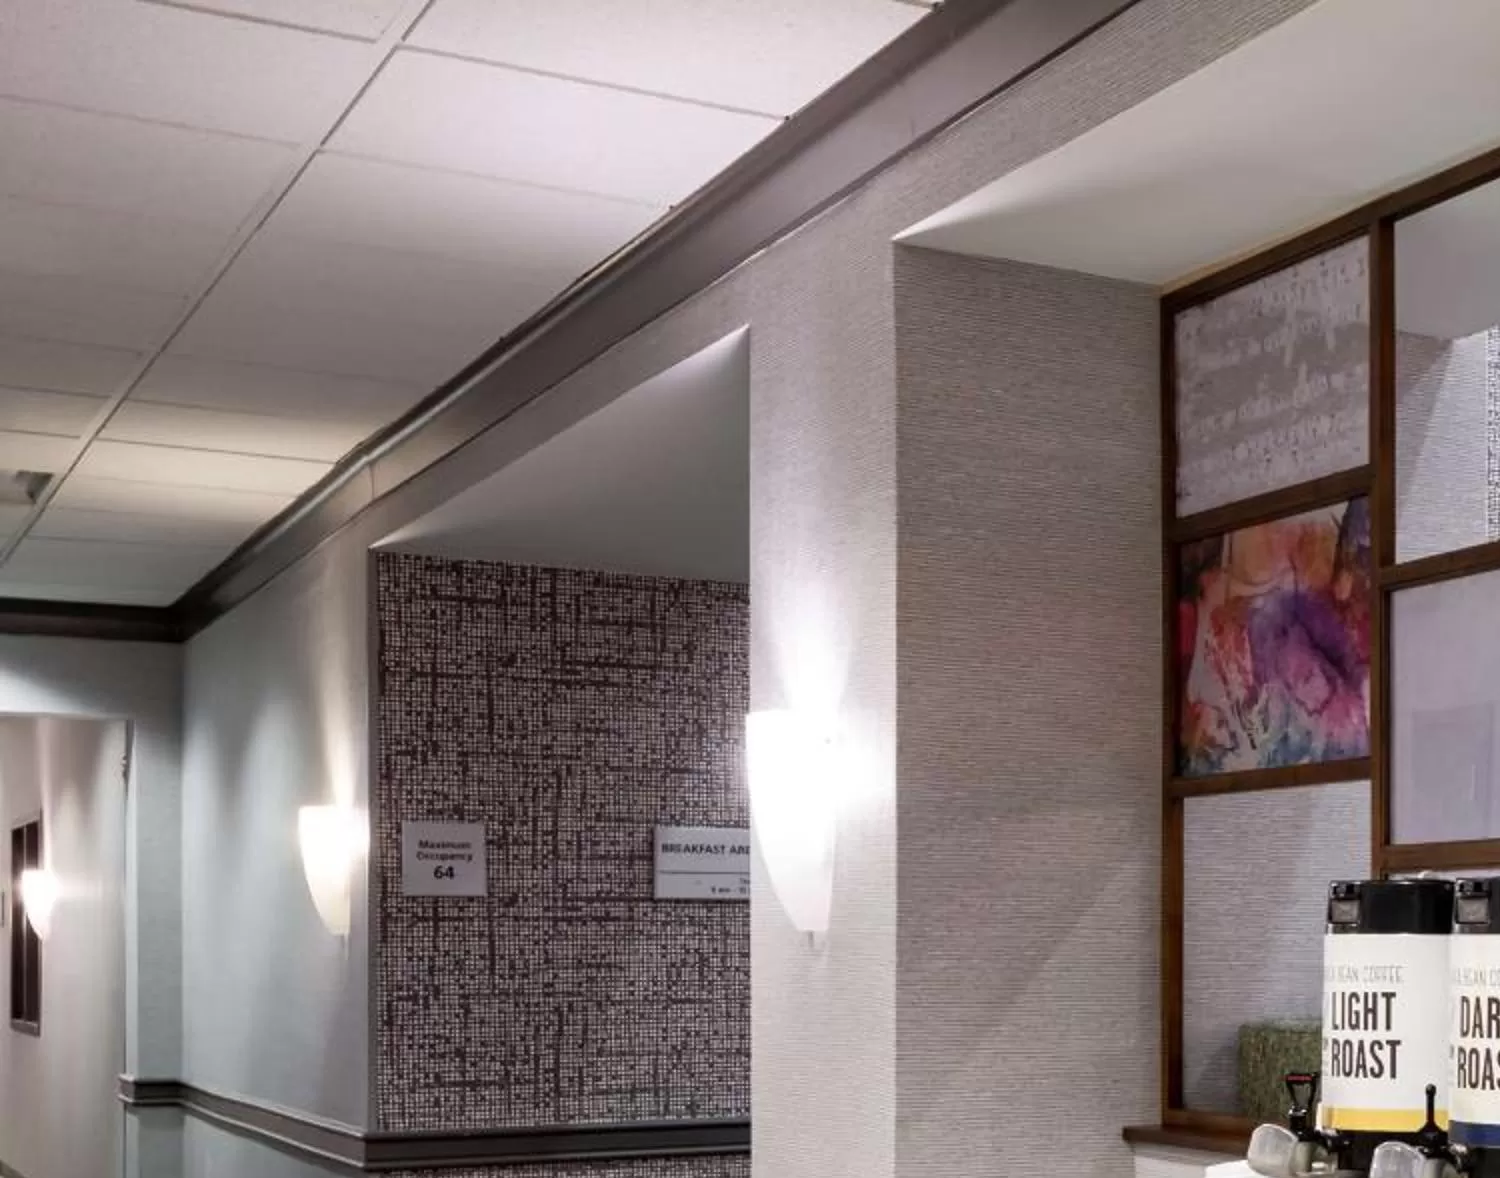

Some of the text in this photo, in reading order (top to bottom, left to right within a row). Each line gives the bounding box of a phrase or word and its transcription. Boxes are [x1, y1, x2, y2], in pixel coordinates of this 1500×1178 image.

[662, 844, 726, 855] BREAKFAST
[433, 866, 455, 880] 64
[1331, 991, 1397, 1031] LIGHT
[1331, 1037, 1402, 1079] ROAST
